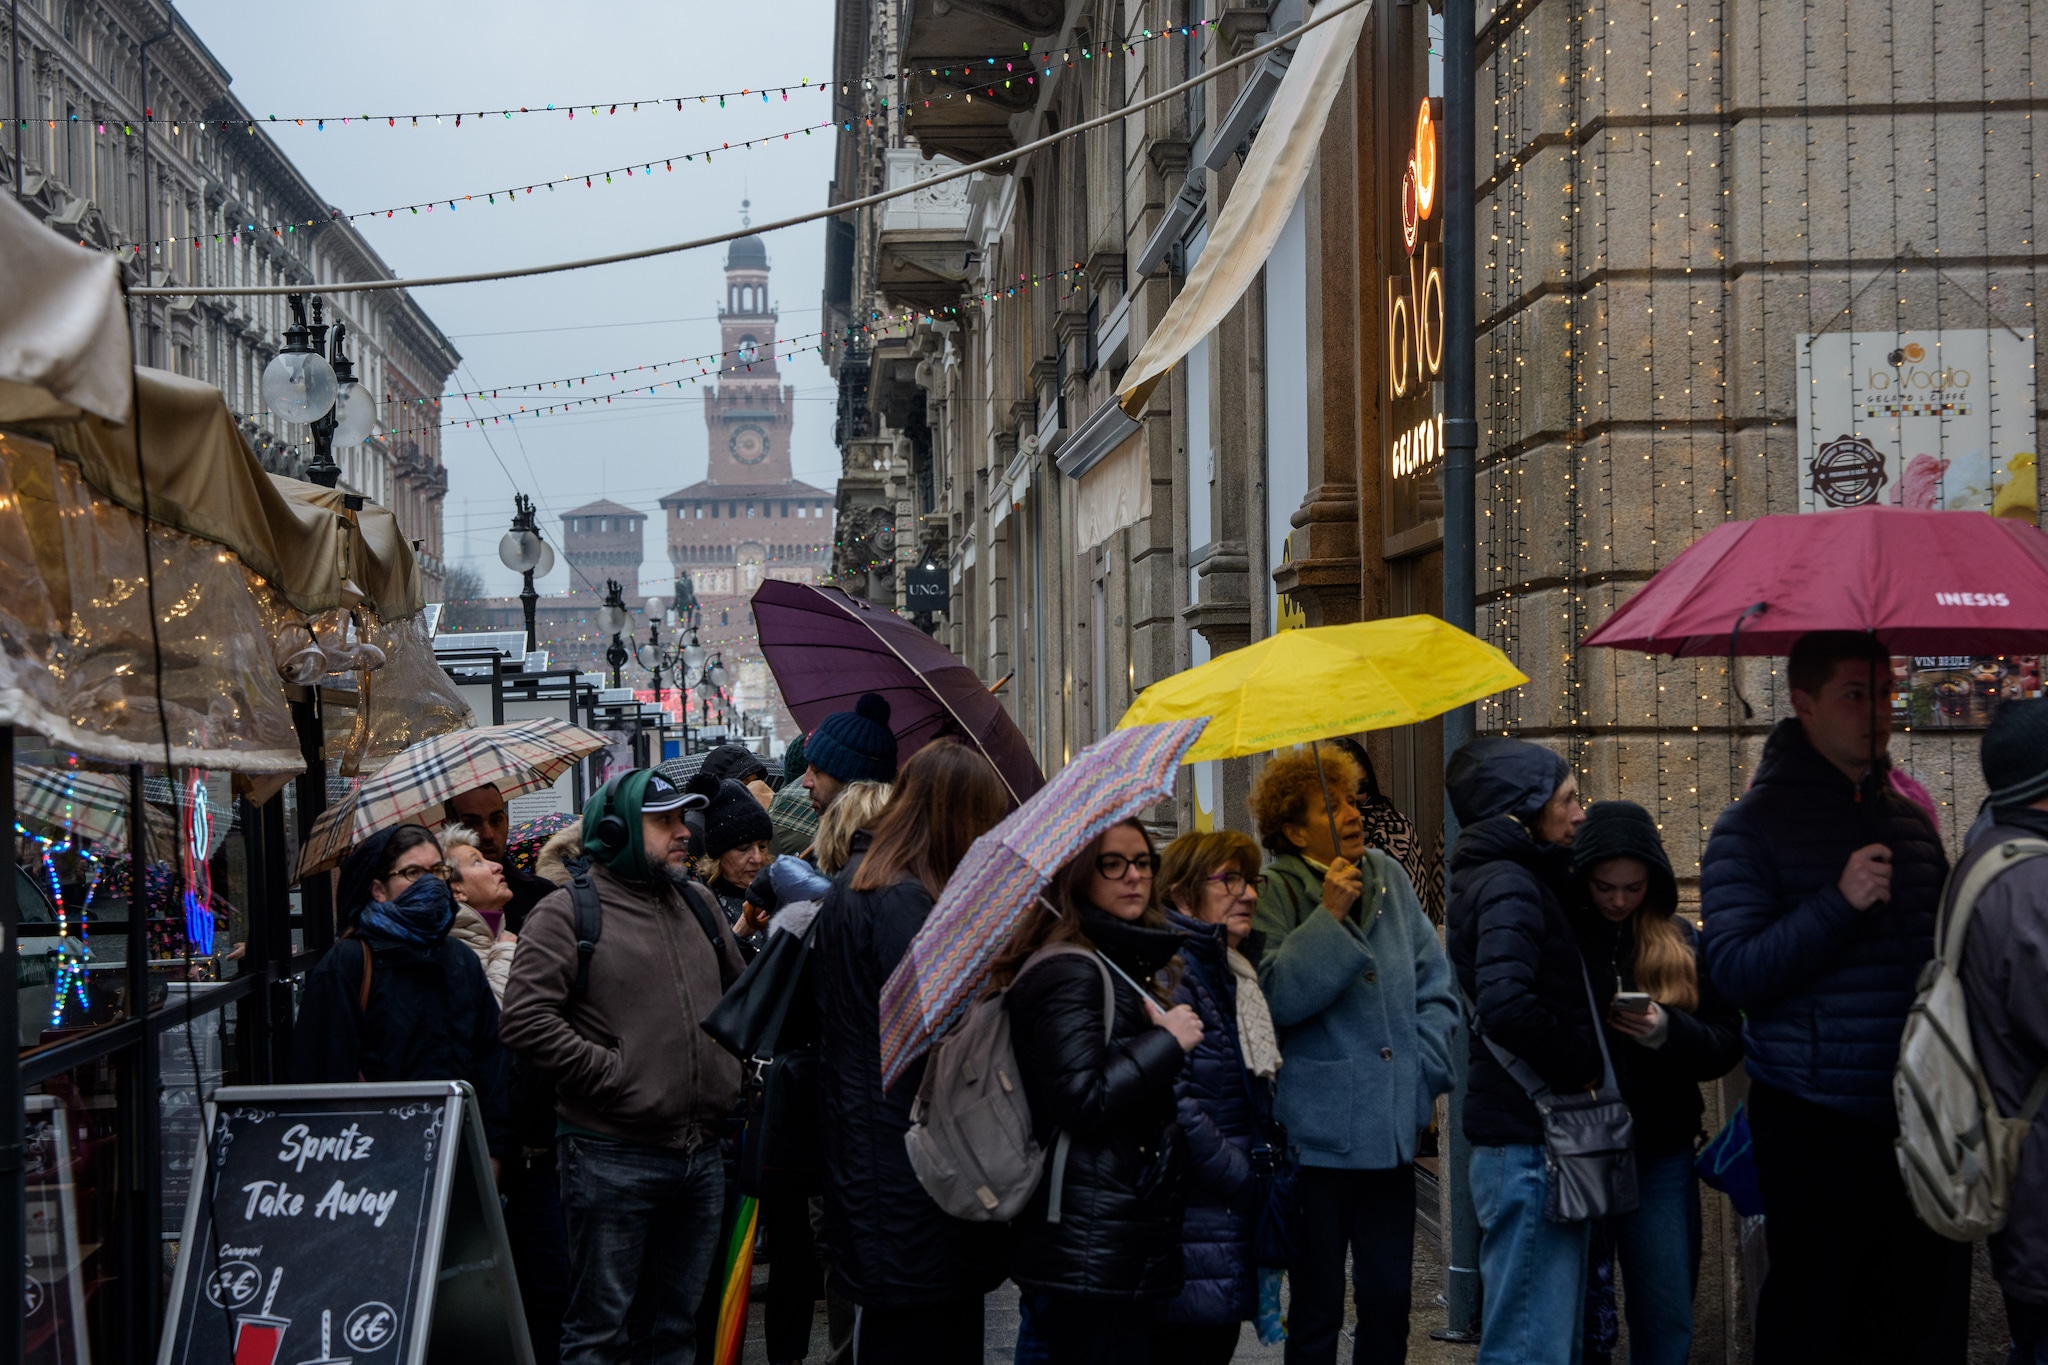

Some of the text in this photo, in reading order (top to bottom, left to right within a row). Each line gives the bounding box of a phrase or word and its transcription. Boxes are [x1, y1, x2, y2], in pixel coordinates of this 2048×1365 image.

[1898, 365, 1971, 392] Voglia
[1392, 418, 1435, 480] GELATO
[1935, 592, 2010, 607] INESIS
[1914, 656, 1937, 667] VIN
[1248, 709, 1396, 744] UNITED COLORS OF BENETTON
[277, 1122, 375, 1173] Spritz
[242, 1179, 399, 1228] Take Away
[218, 1243, 264, 1261] Campari
[350, 1310, 390, 1344] 6€
